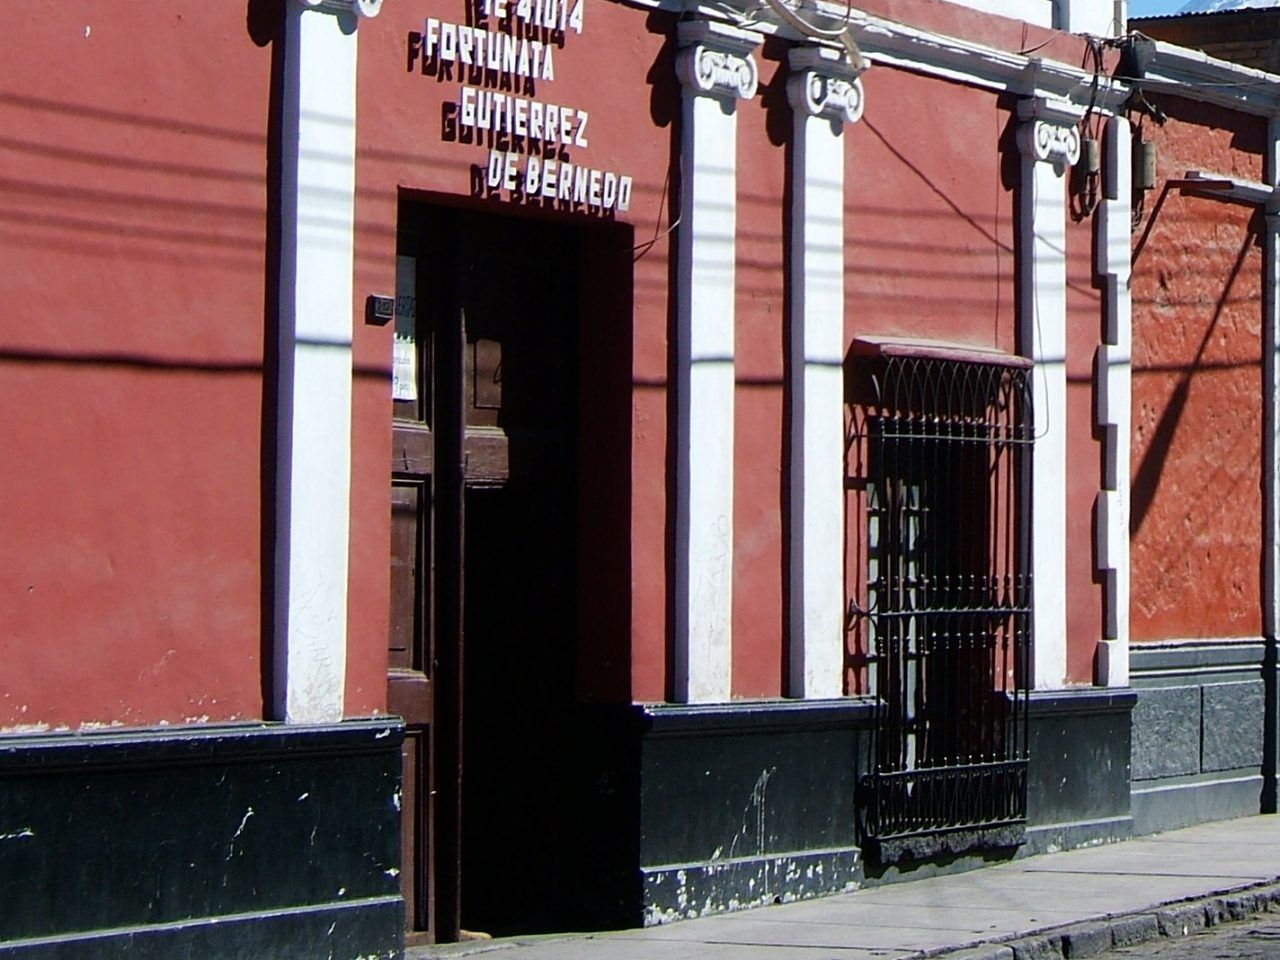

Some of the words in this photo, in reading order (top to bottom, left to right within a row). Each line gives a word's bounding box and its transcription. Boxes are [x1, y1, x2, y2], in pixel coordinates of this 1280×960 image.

[425, 17, 554, 81] FORTUNATA
[461, 86, 588, 148] GUTIERREZ
[487, 149, 519, 190] DE
[525, 154, 633, 211] BERNEDO
